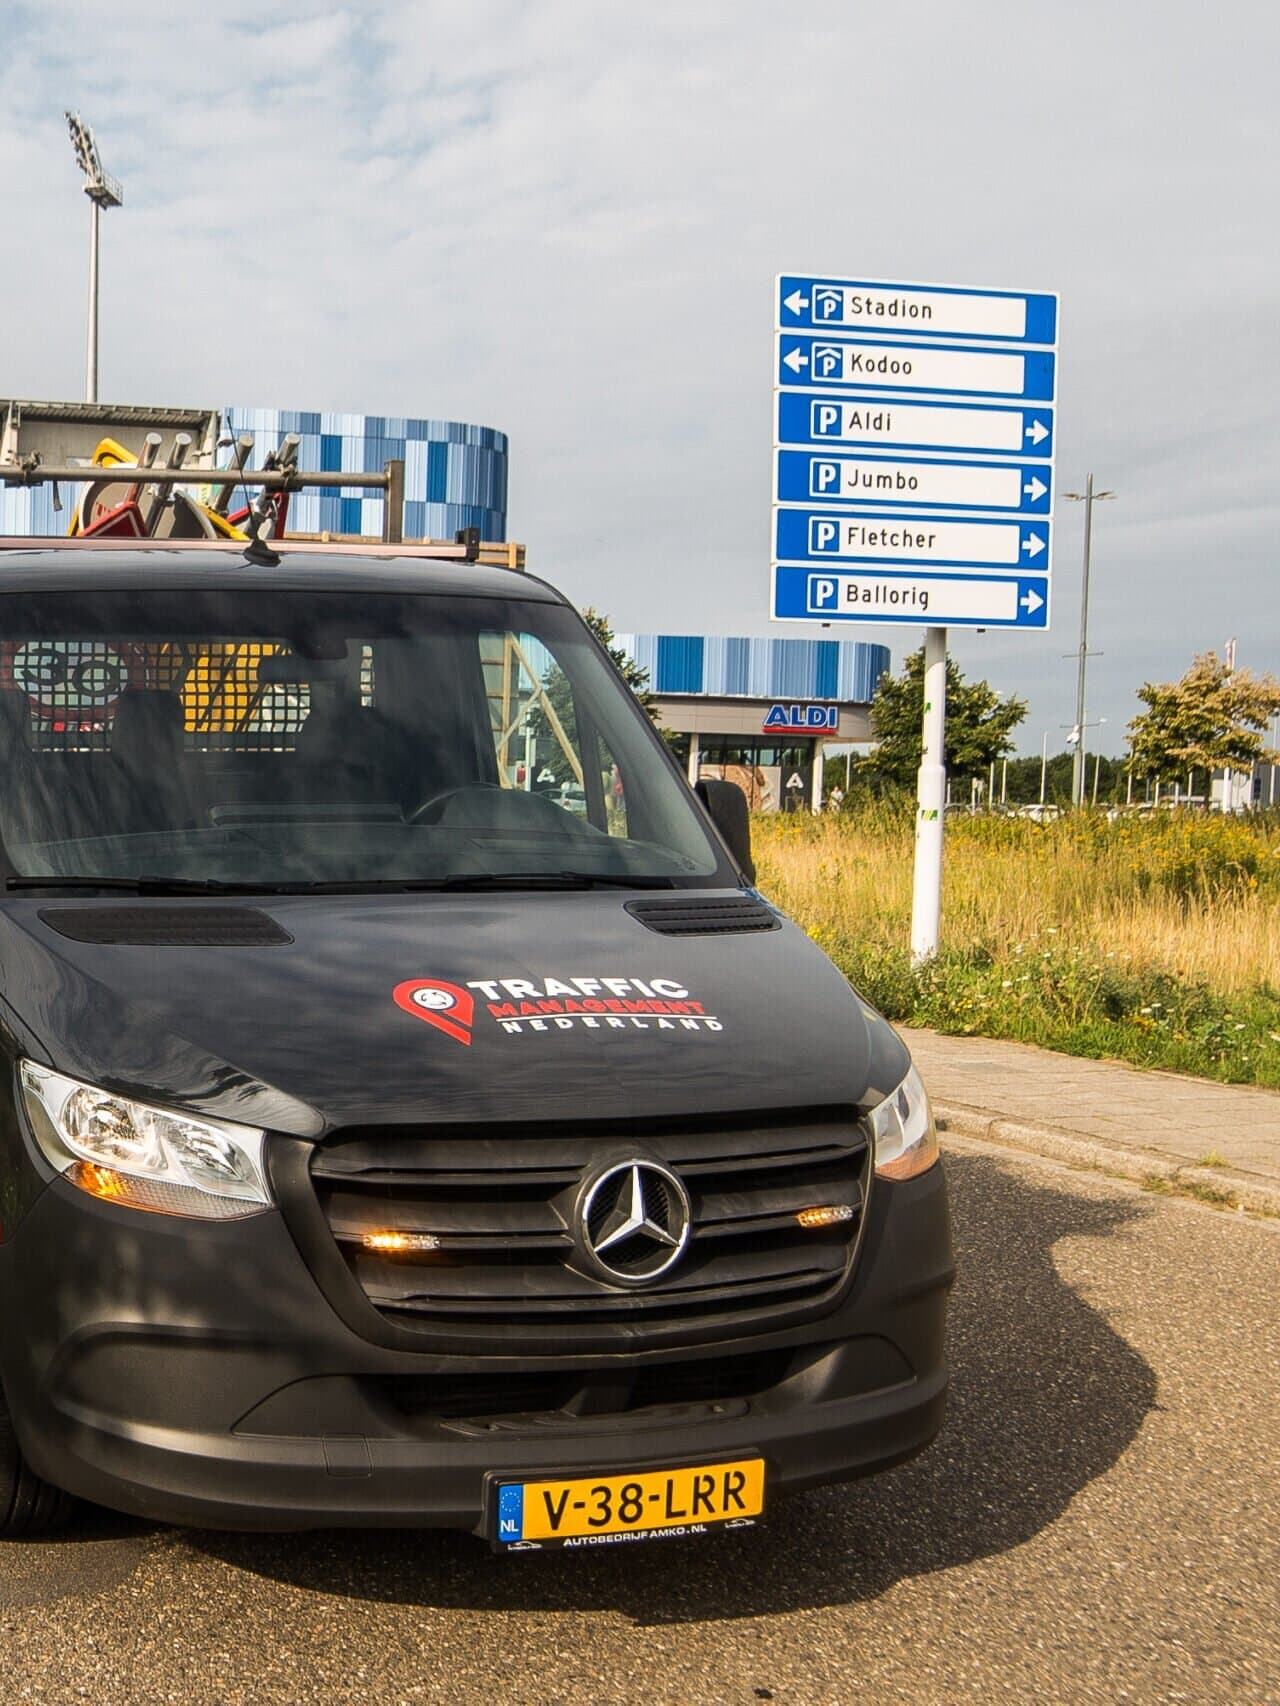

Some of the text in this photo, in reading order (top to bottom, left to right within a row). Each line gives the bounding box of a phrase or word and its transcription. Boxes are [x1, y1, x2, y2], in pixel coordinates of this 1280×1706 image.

[851, 296, 933, 319] Stadion
[851, 353, 913, 375] Kodoo
[849, 411, 892, 432] Aldi
[848, 469, 919, 490] Jumbo
[847, 526, 937, 549] Fletcher
[847, 584, 930, 611] Ballorig
[763, 704, 839, 729] ALDI
[465, 977, 689, 1001] TRAFFIC
[486, 998, 706, 1018] MANAGEMENT
[501, 1016, 723, 1034] NEDERLAND
[500, 1470, 747, 1533] NL V-38-LRR
